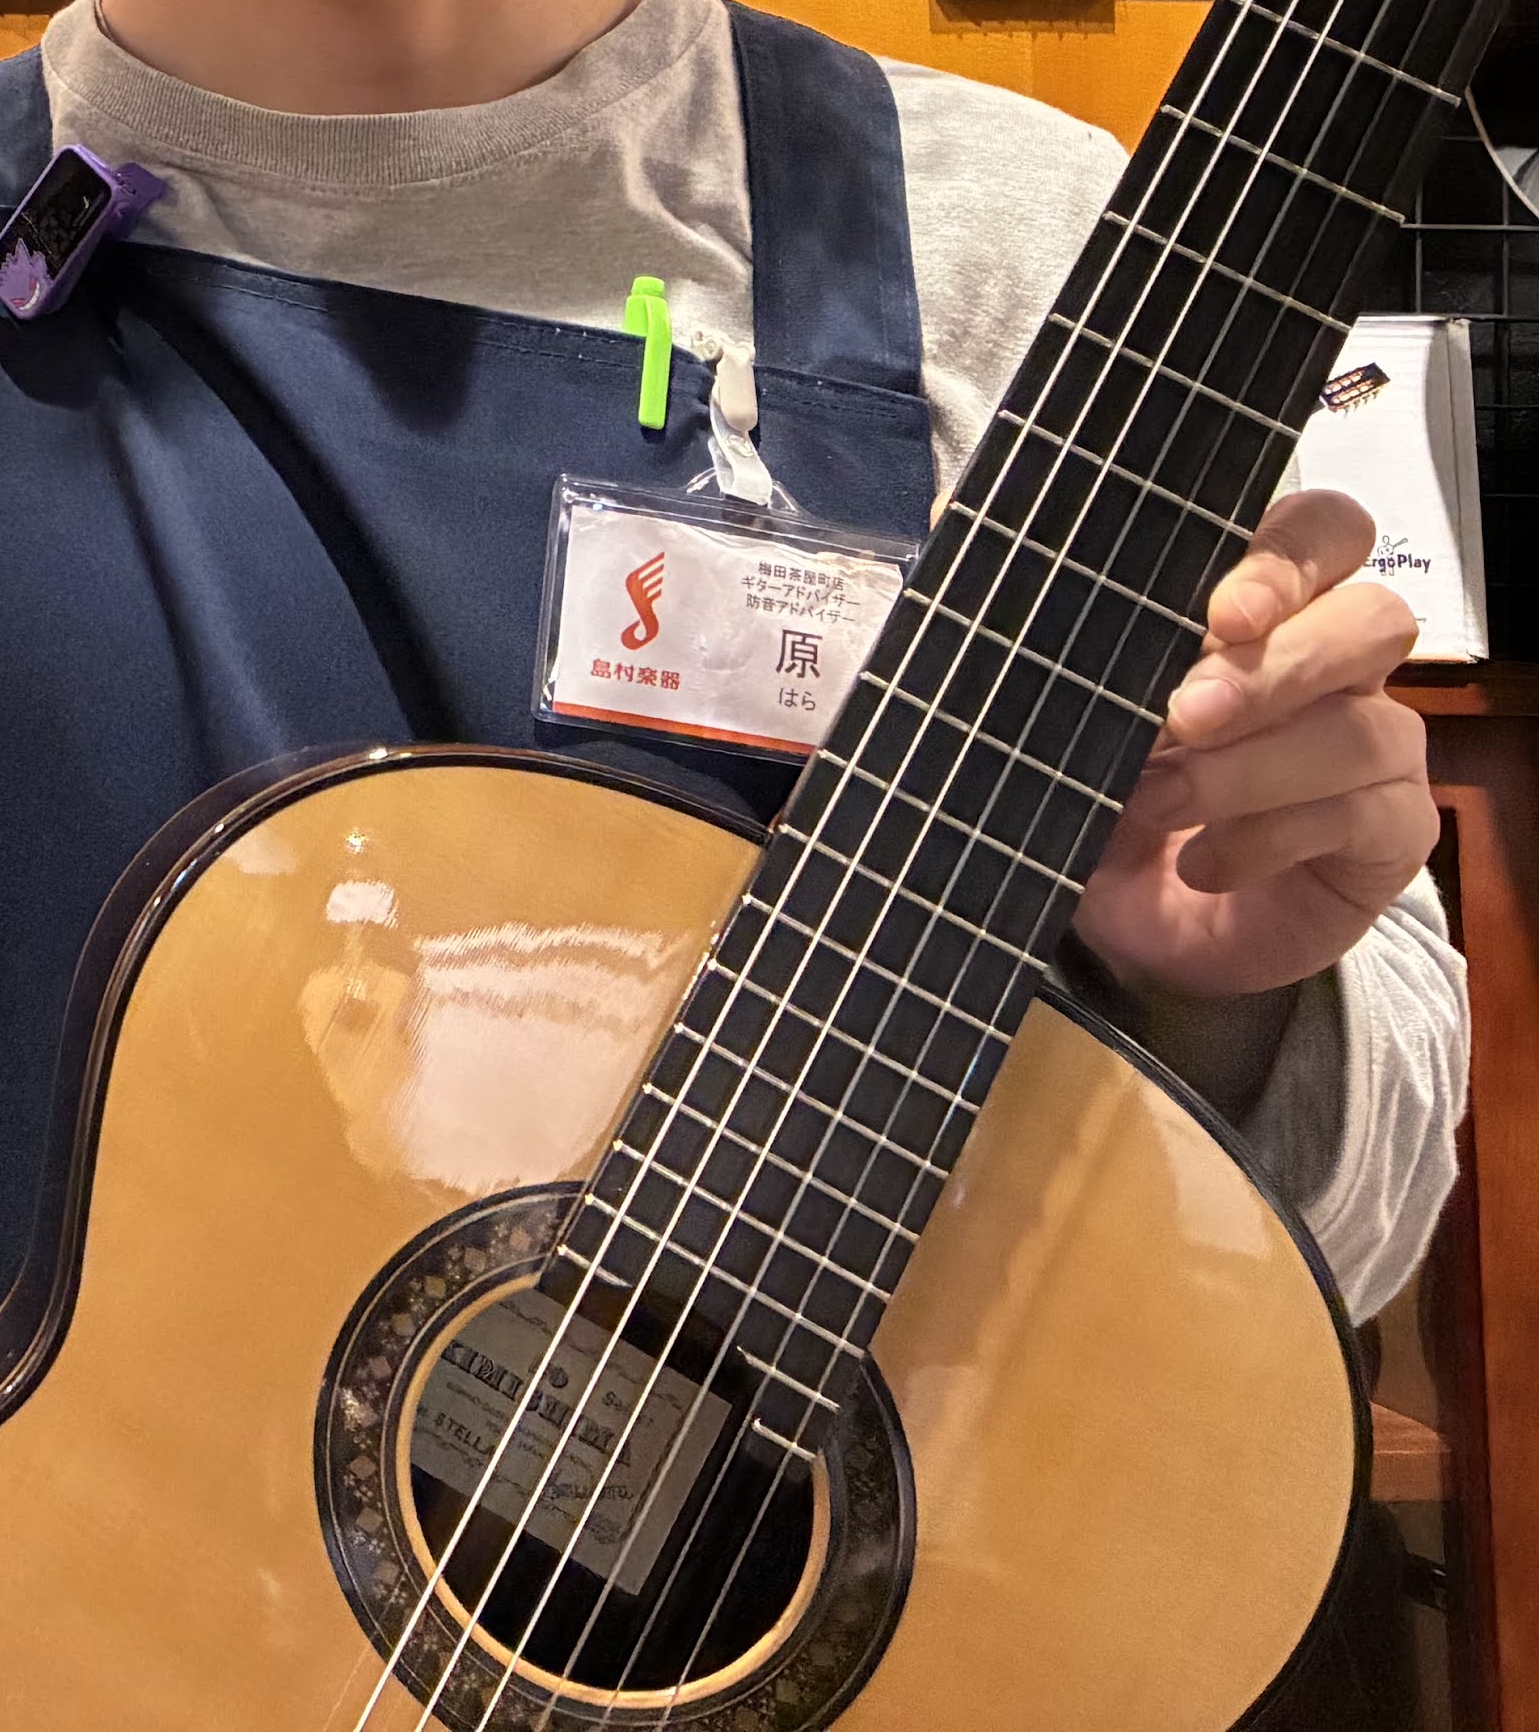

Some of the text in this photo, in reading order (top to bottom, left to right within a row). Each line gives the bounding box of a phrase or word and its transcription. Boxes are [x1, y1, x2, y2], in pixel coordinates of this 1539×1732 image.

[740, 576, 862, 608] ギターアドバイザー
[746, 593, 856, 624] 防音アドバイザー
[775, 629, 823, 679] 原
[589, 658, 681, 691] 島村楽器
[778, 687, 818, 712] はら
